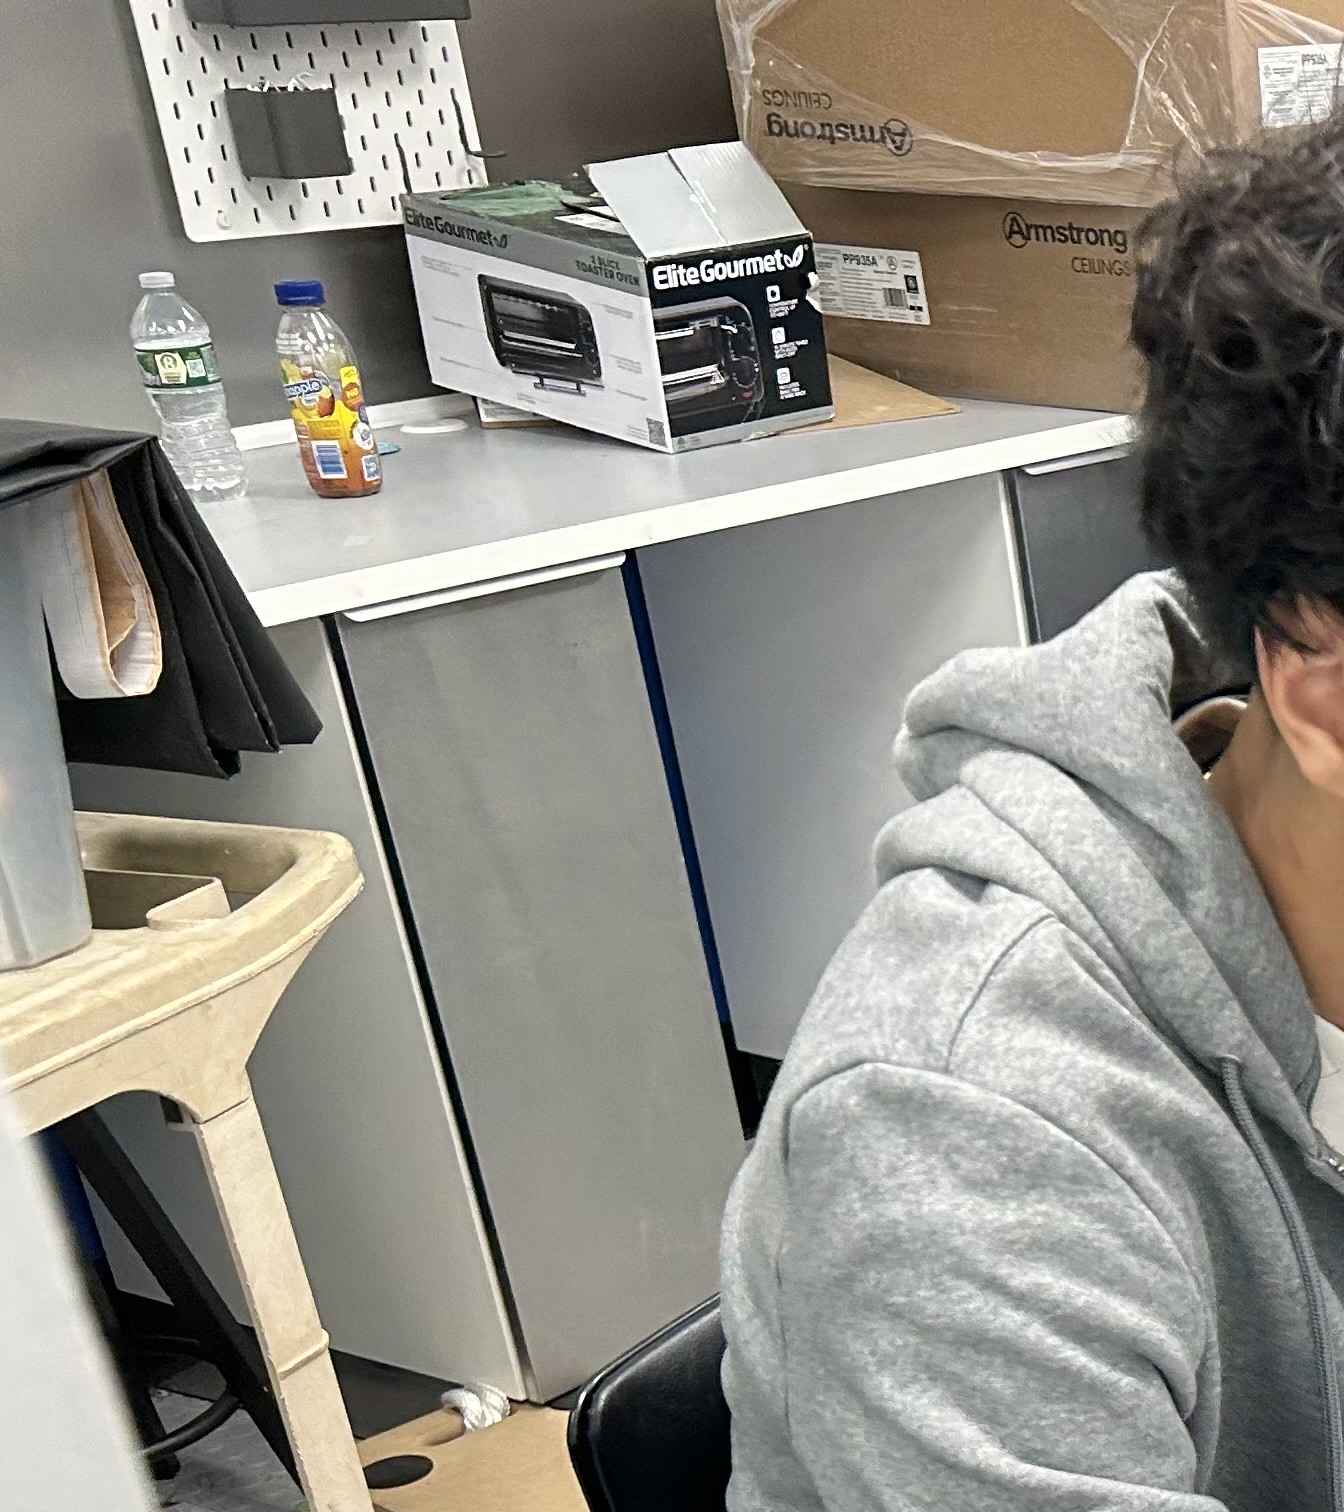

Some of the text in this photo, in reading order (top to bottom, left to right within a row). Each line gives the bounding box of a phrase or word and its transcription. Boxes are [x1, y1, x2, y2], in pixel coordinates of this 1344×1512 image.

[762, 88, 833, 110] CEILINGS
[765, 112, 913, 156] Armstrong
[1003, 211, 1128, 254] Armstrong
[1071, 256, 1132, 277] CEILINGS
